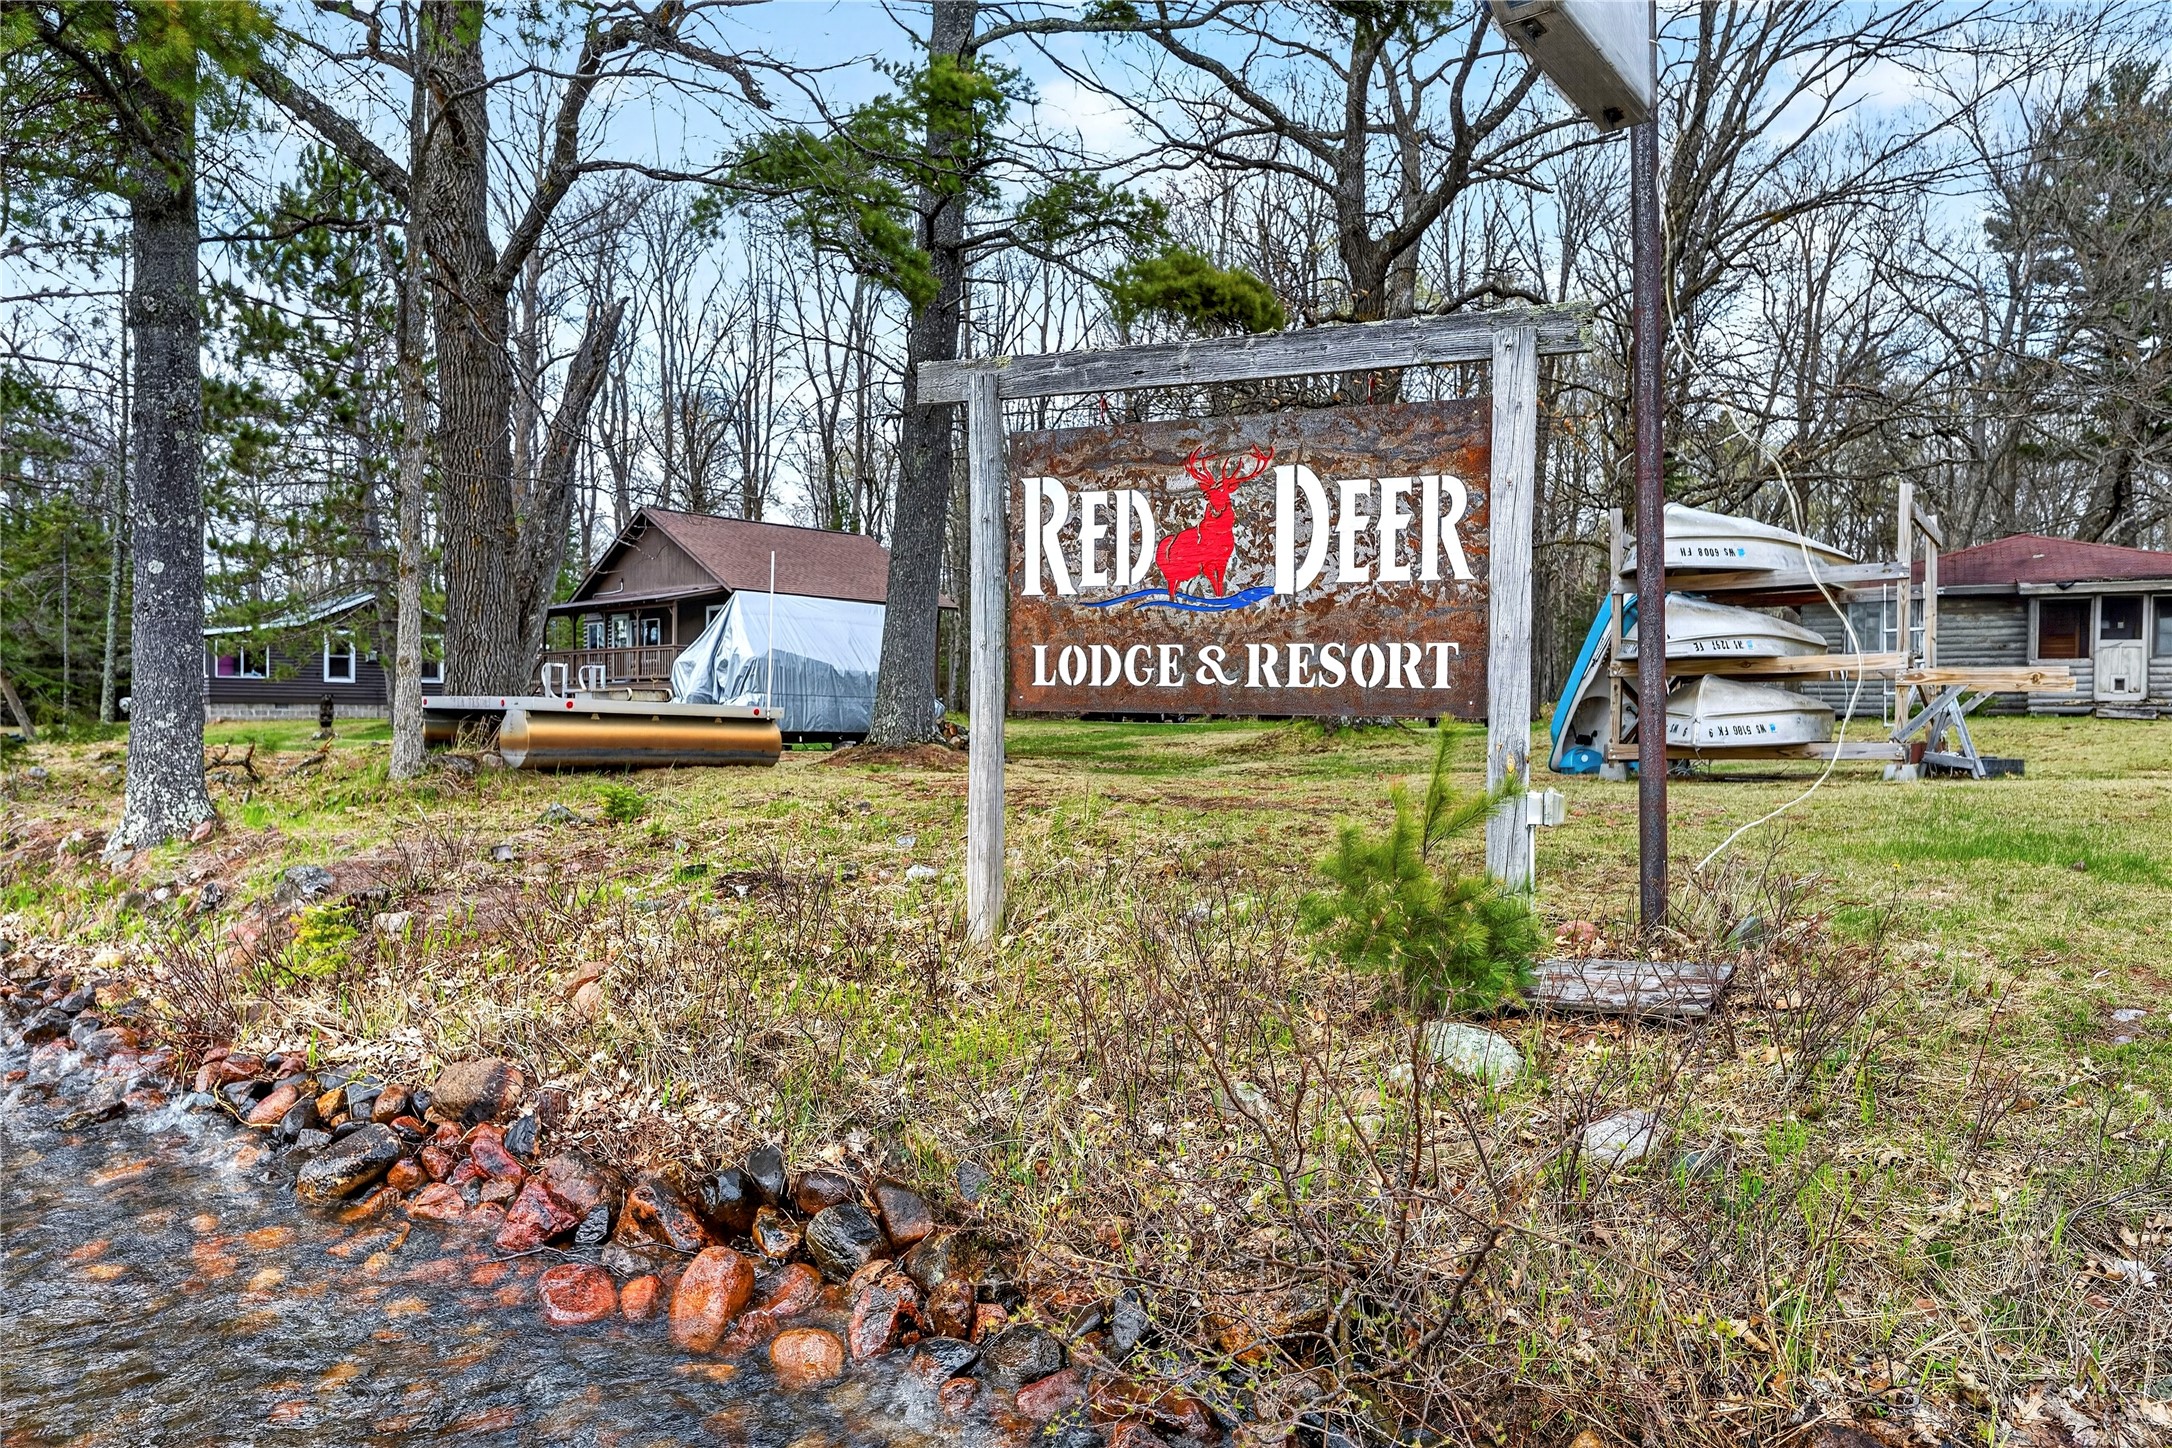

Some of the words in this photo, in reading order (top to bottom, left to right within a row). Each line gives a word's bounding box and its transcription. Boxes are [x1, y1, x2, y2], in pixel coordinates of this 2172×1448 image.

[1020, 476, 1156, 597] RED
[1273, 464, 1476, 596] DEER
[1031, 644, 1186, 687] LODGE
[1195, 645, 1238, 686] &
[1244, 642, 1460, 689] RESORT
